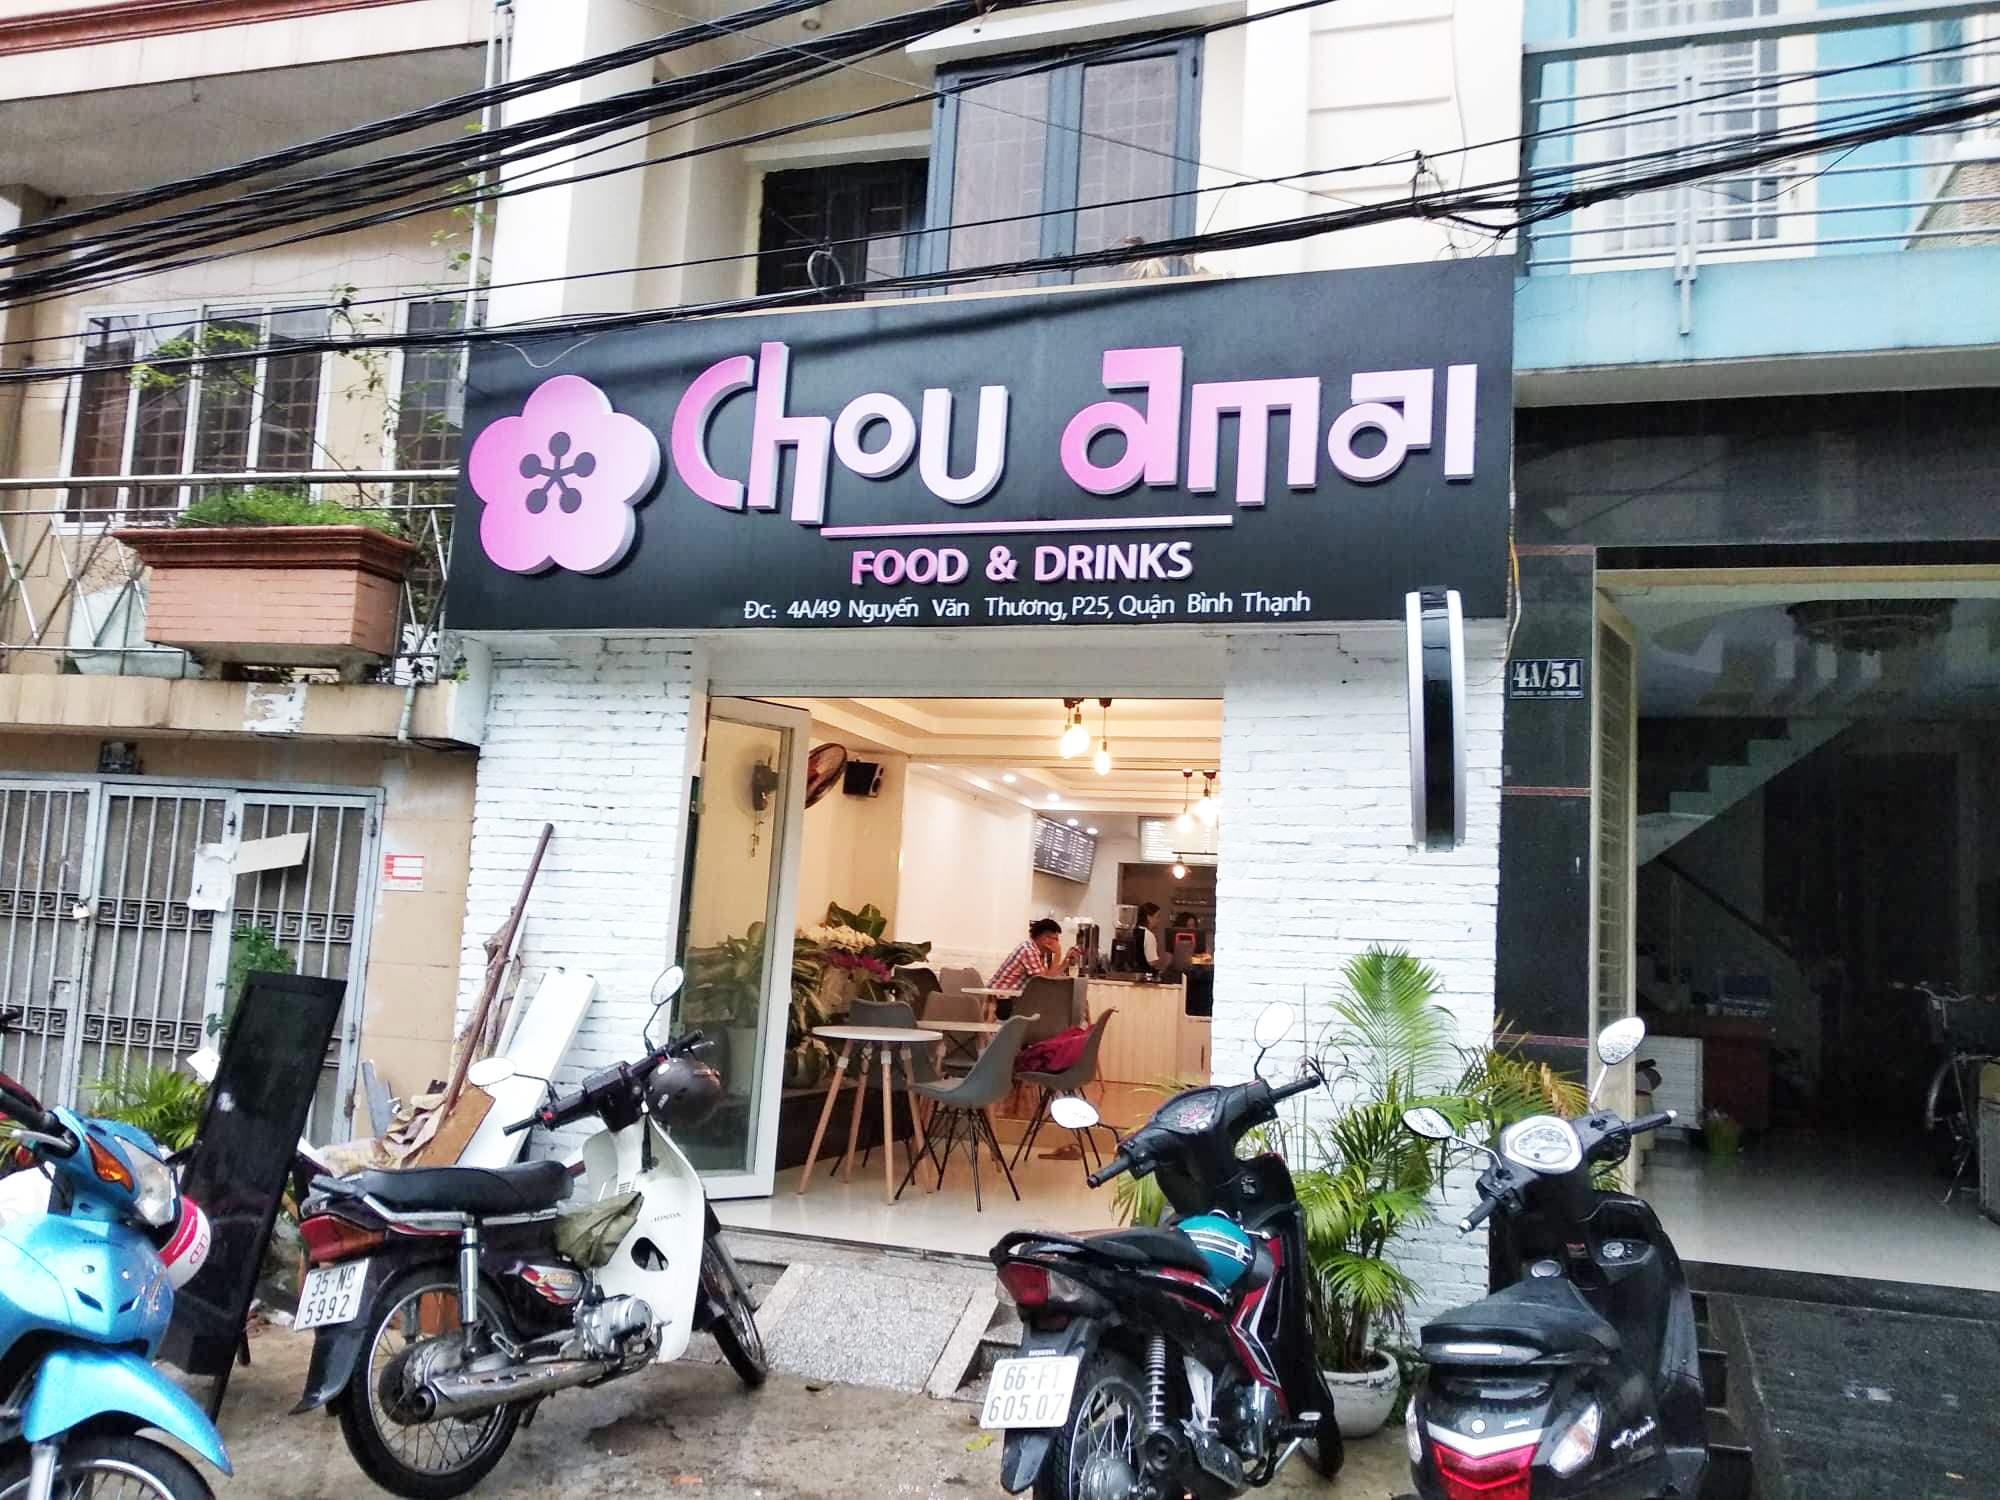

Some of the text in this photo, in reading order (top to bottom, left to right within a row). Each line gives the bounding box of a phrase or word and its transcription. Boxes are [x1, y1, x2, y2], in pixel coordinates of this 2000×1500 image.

[671, 340, 1009, 525] Chou
[851, 541, 1194, 586] FOOD & DRINKS
[787, 599, 841, 619] 4A/49
[932, 598, 970, 617] Văn
[984, 596, 1068, 621] Thương,
[1071, 596, 1114, 620] P25,
[1118, 594, 1175, 619] Quận
[1187, 592, 1233, 614] Bình
[1241, 591, 1311, 616] Thạnh
[1513, 660, 1580, 689] 4A/51
[304, 1294, 350, 1325] 5992
[988, 1393, 1065, 1422] 605.07
